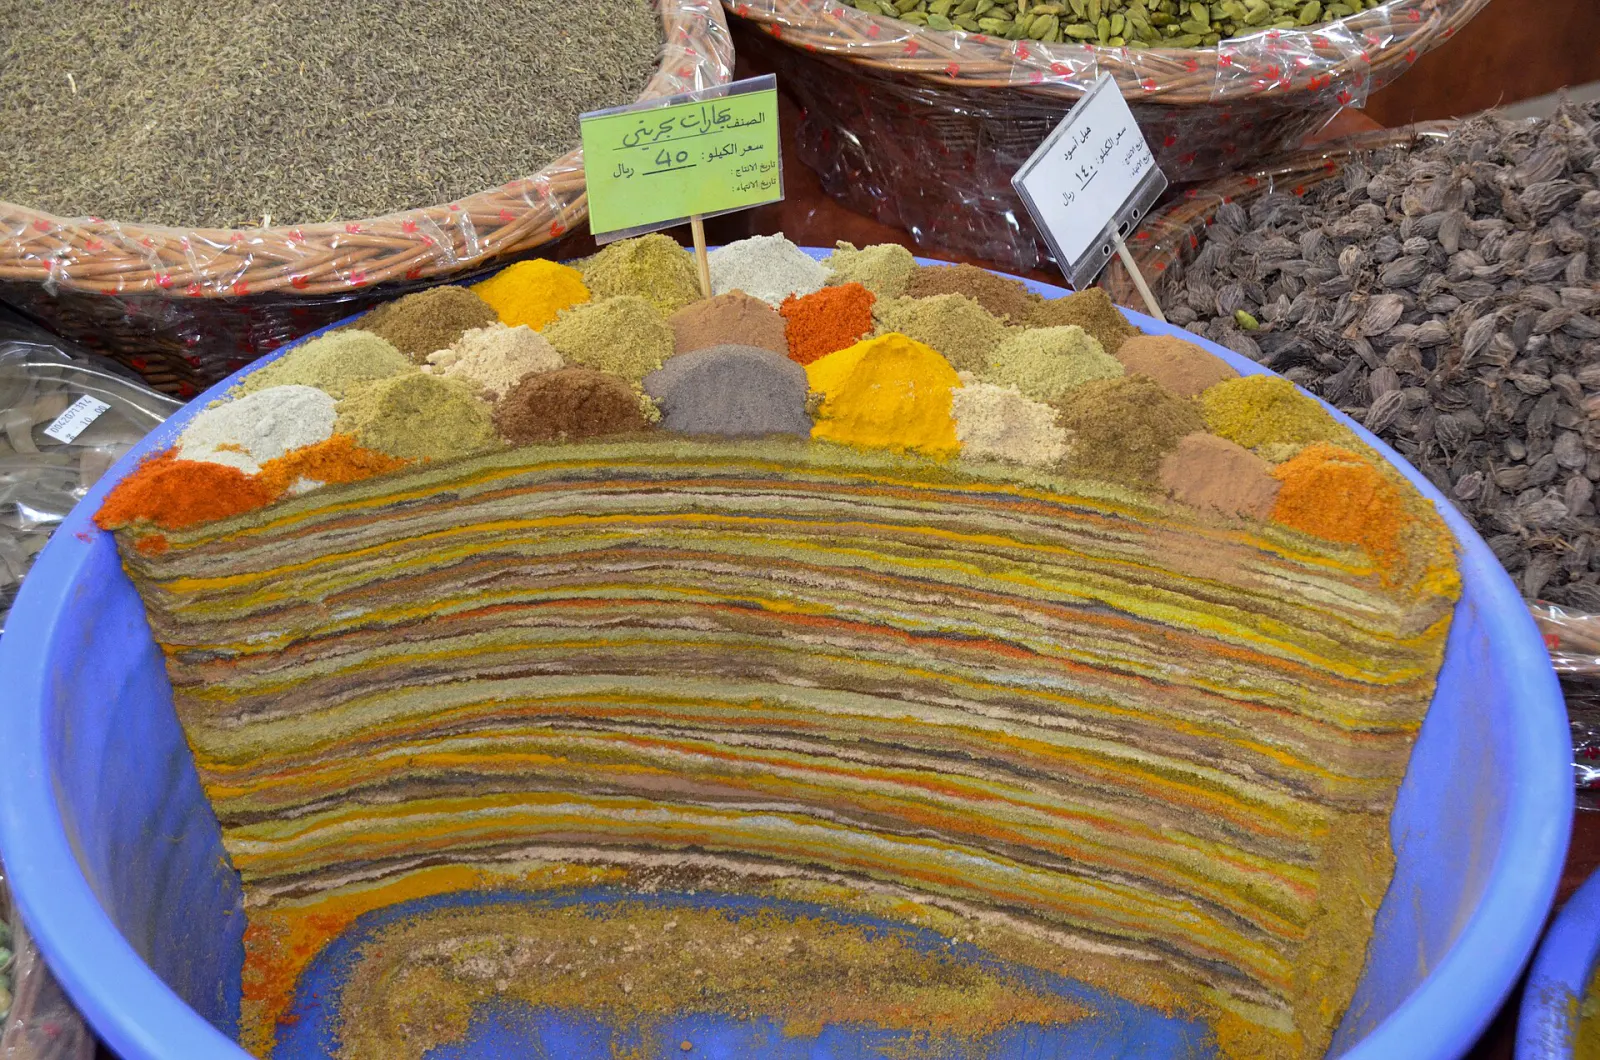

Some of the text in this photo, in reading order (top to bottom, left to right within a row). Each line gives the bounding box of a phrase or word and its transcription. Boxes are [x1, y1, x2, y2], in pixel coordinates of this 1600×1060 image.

[1064, 126, 1092, 161] هيل أسود
[1115, 127, 1126, 146] سعر
[740, 144, 763, 156] سعر
[655, 149, 688, 167] 40
[613, 163, 634, 178] ريال
[760, 161, 775, 173] تاريخ
[760, 178, 776, 190] تاريخ
[1062, 191, 1075, 207] ريال
